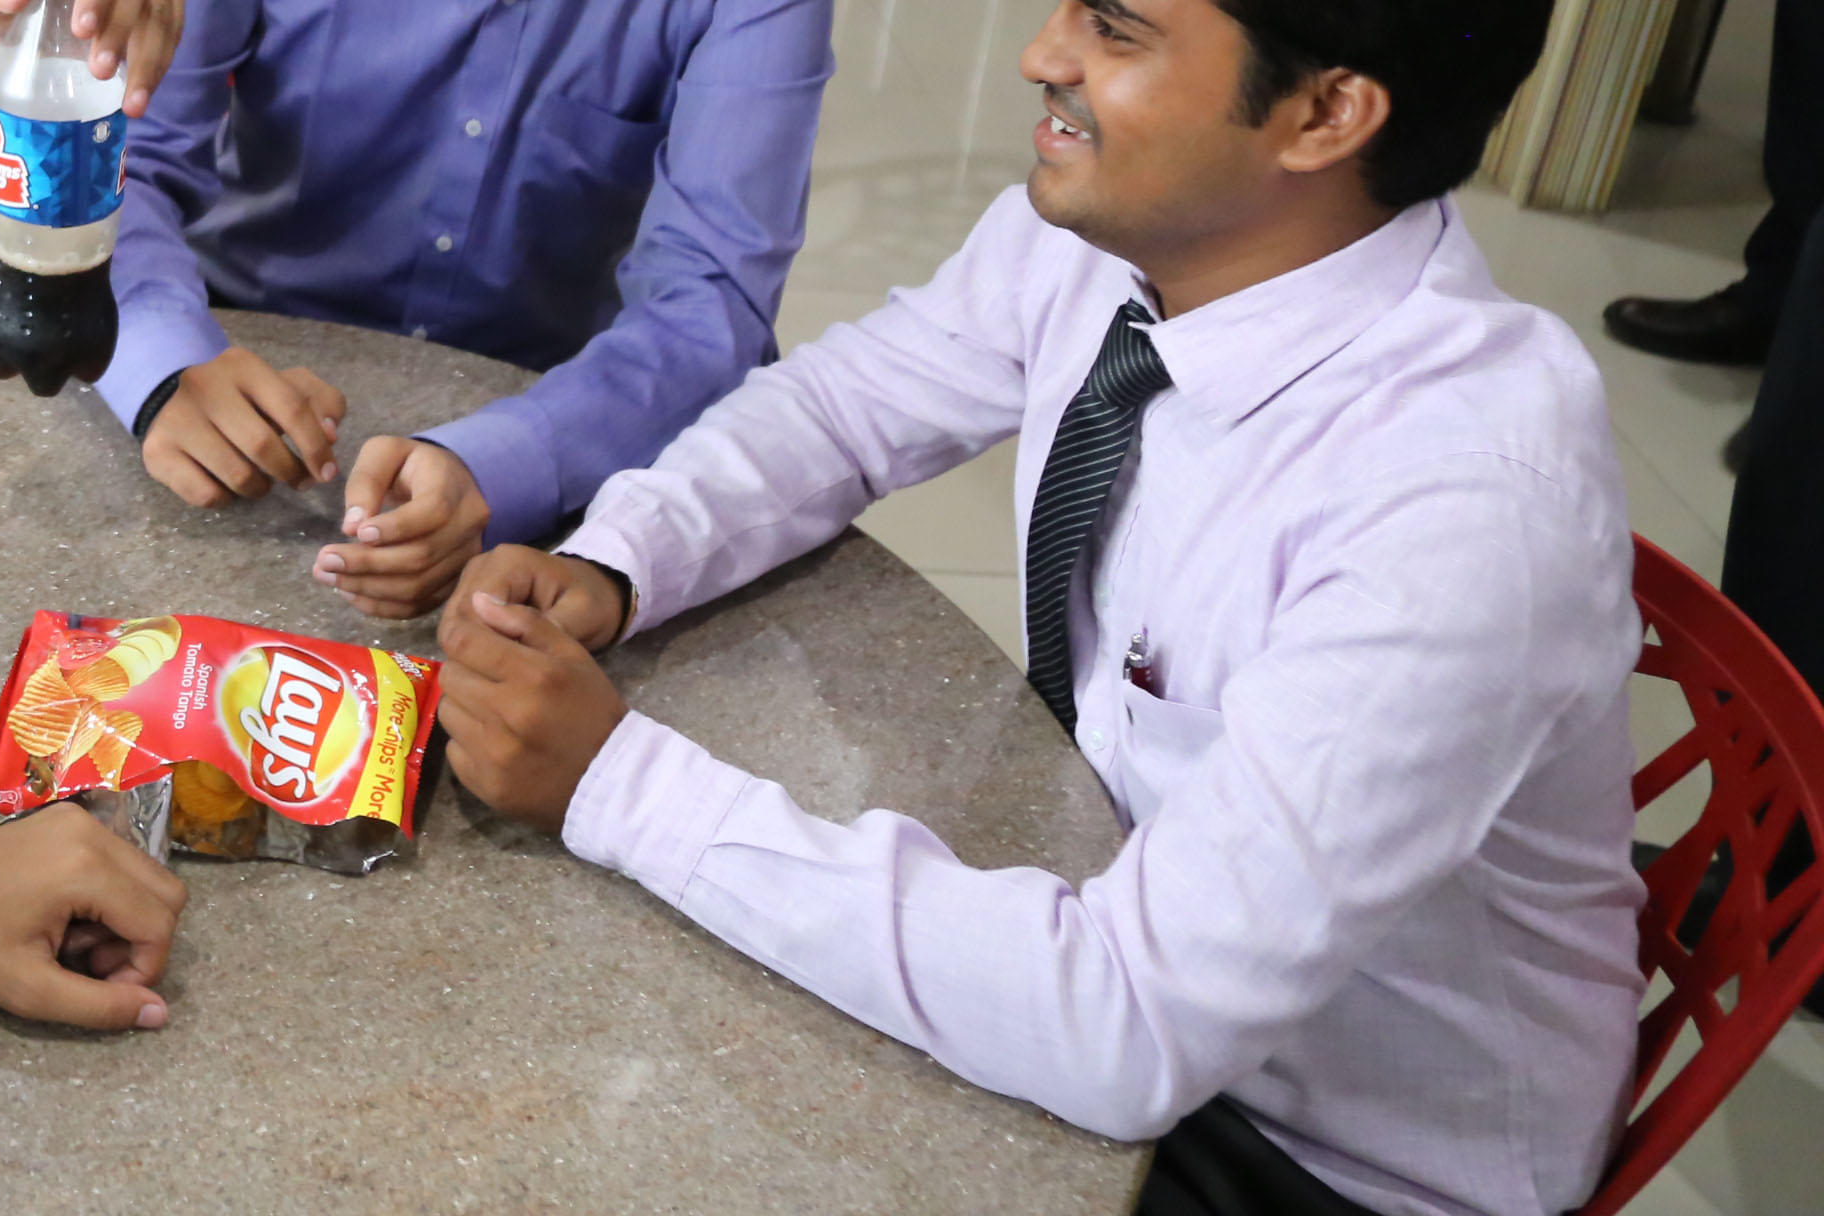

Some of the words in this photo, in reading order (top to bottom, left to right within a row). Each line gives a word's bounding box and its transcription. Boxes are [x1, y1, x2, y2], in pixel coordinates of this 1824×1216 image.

[182, 643, 202, 687] Tomato
[192, 664, 213, 710] Spanish
[173, 690, 193, 729] Tango
[240, 652, 341, 798] Lay's
[389, 691, 413, 725] More
